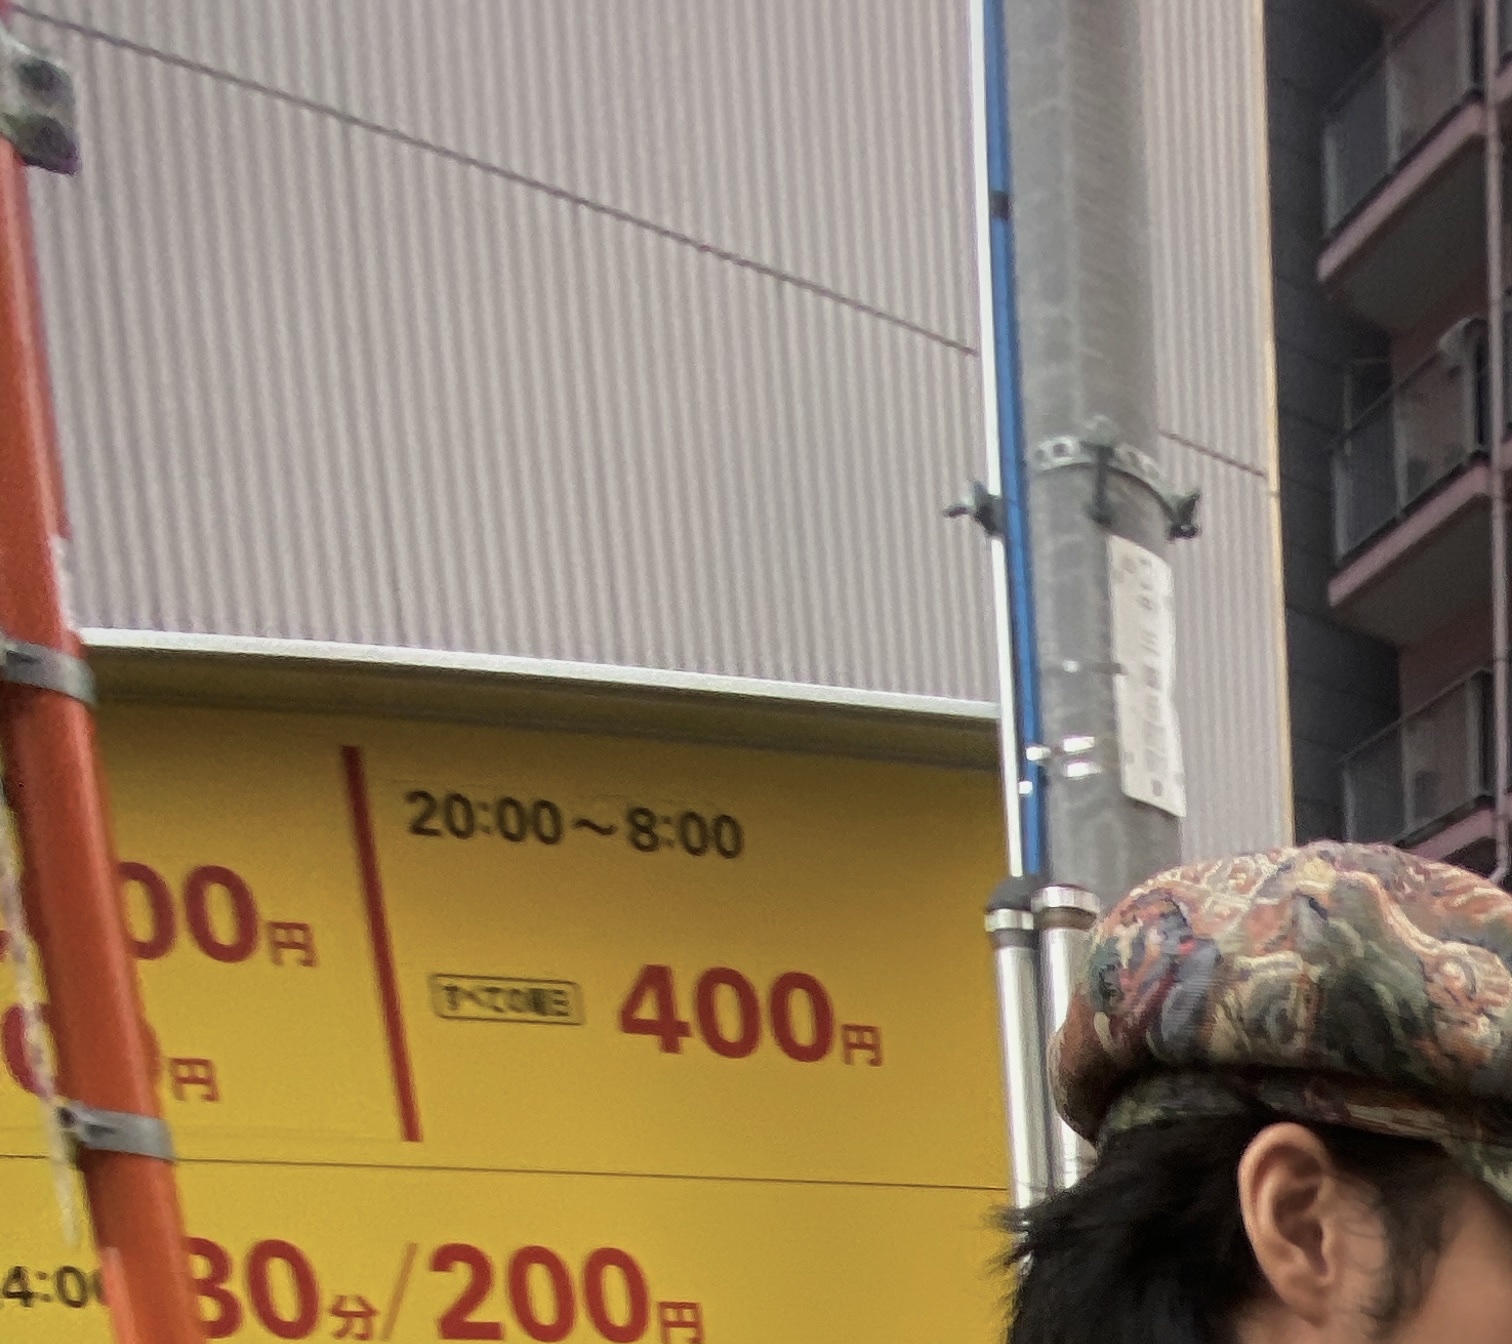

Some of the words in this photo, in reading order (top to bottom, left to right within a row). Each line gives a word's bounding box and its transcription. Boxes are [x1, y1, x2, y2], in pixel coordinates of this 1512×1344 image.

[114, 860, 318, 968] 00円
[617, 963, 883, 1067] 400円
[0, 1264, 106, 1309] 4:0
